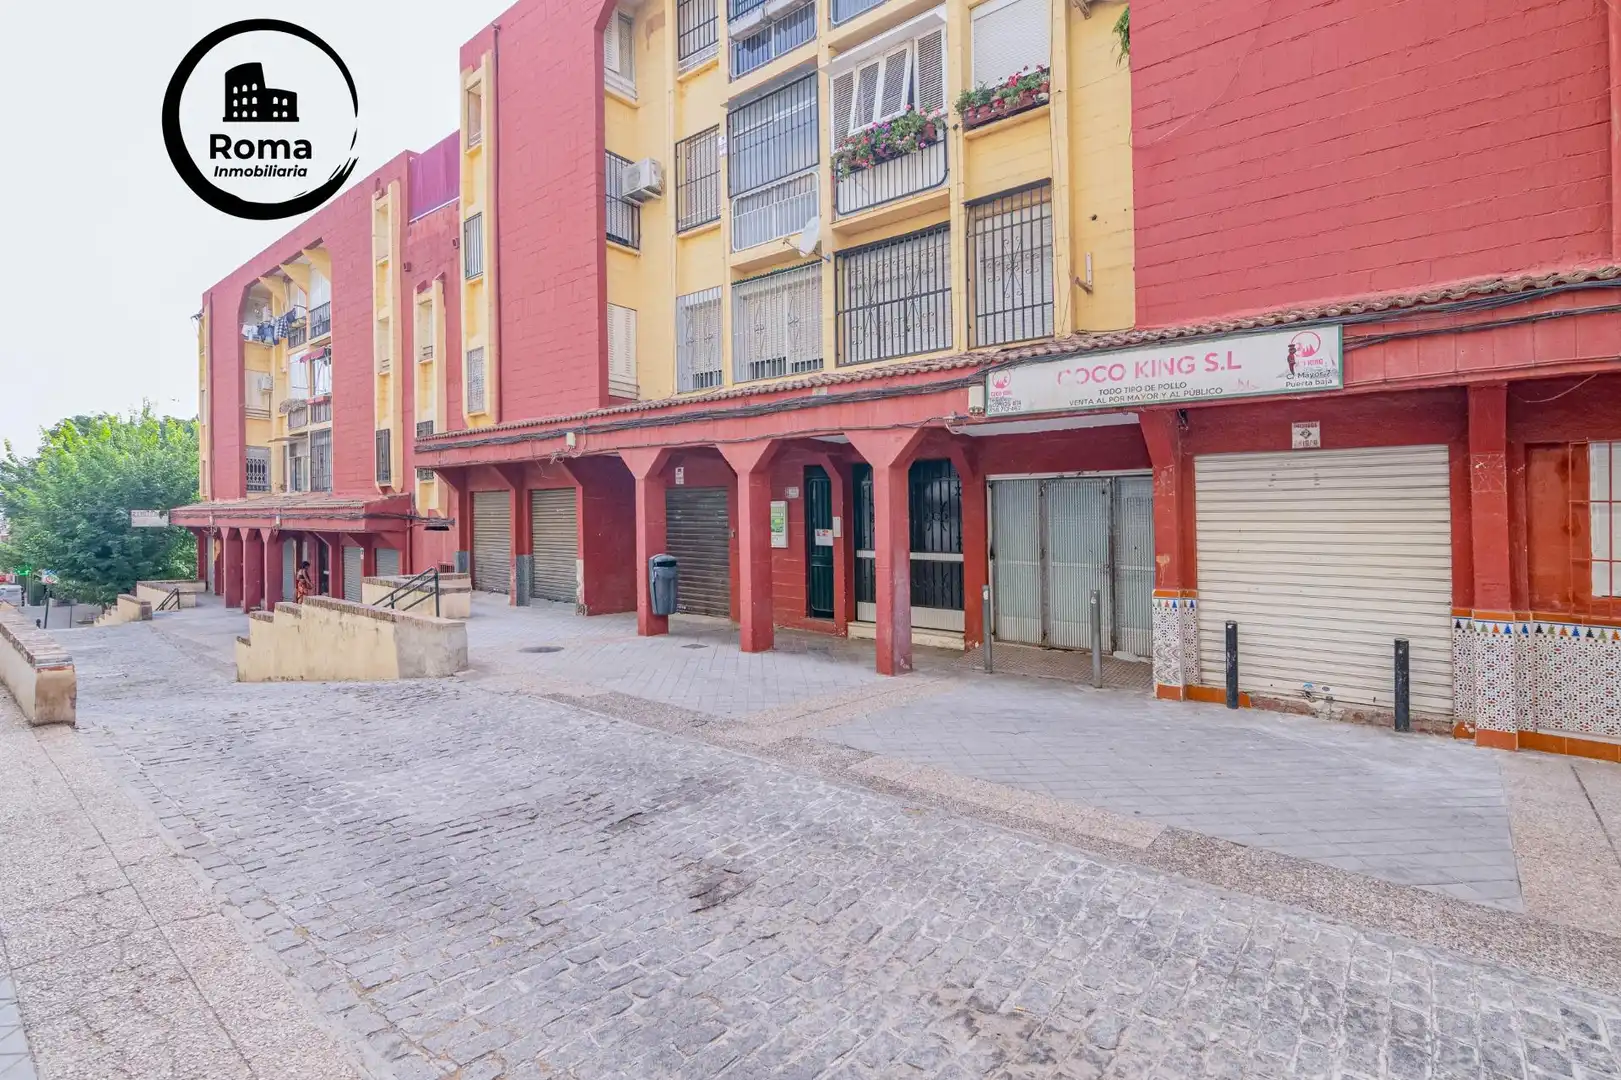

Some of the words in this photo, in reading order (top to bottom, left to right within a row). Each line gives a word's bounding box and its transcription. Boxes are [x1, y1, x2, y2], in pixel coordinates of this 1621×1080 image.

[1057, 363, 1126, 385] COCO
[1134, 355, 1196, 379] KING
[1204, 350, 1242, 373] S.L
[1099, 387, 1122, 396] TODO
[1124, 385, 1143, 394] TIPO
[1144, 384, 1157, 393] DE
[1158, 381, 1188, 391] POLLO
[1285, 380, 1313, 388] Puerta
[1069, 397, 1095, 407] VENTA
[1095, 396, 1107, 405] AL
[1108, 395, 1126, 405] POR
[1127, 392, 1159, 403] MAYOR
[1160, 391, 1167, 400] Y
[1169, 390, 1181, 399] AL
[1183, 386, 1224, 398] PÚBLICO
